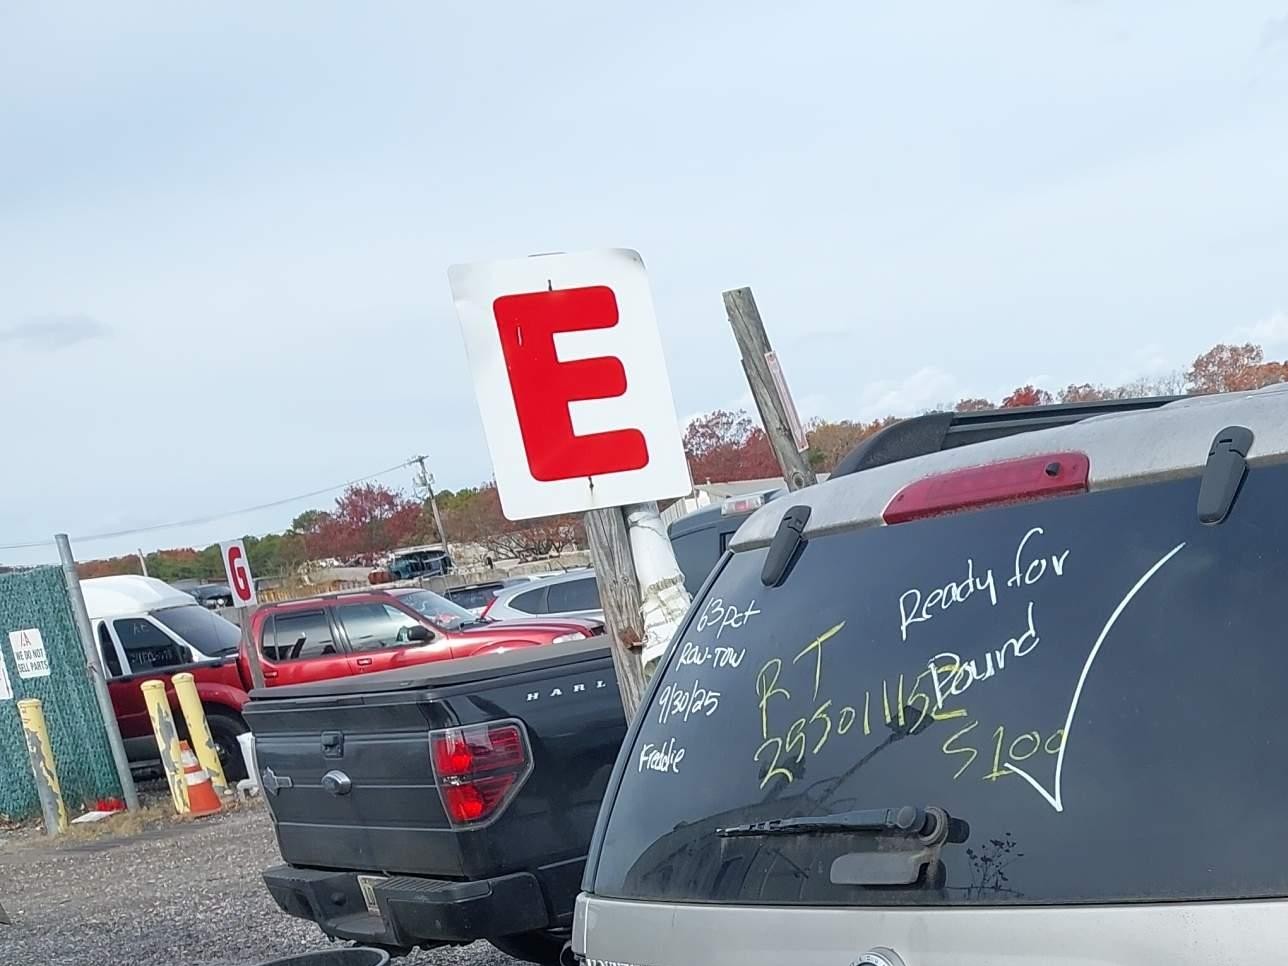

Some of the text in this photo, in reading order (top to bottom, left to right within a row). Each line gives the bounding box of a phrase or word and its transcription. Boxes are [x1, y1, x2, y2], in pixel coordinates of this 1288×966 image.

[493, 285, 650, 482] E
[228, 547, 252, 601] G
[899, 527, 1070, 641] Ready for
[16, 648, 44, 661] WE DO NOT
[18, 660, 49, 673] SELL PARTS
[928, 602, 1040, 710] Pound
[526, 681, 607, 701] HARL
[658, 680, 721, 724] 9/30/25
